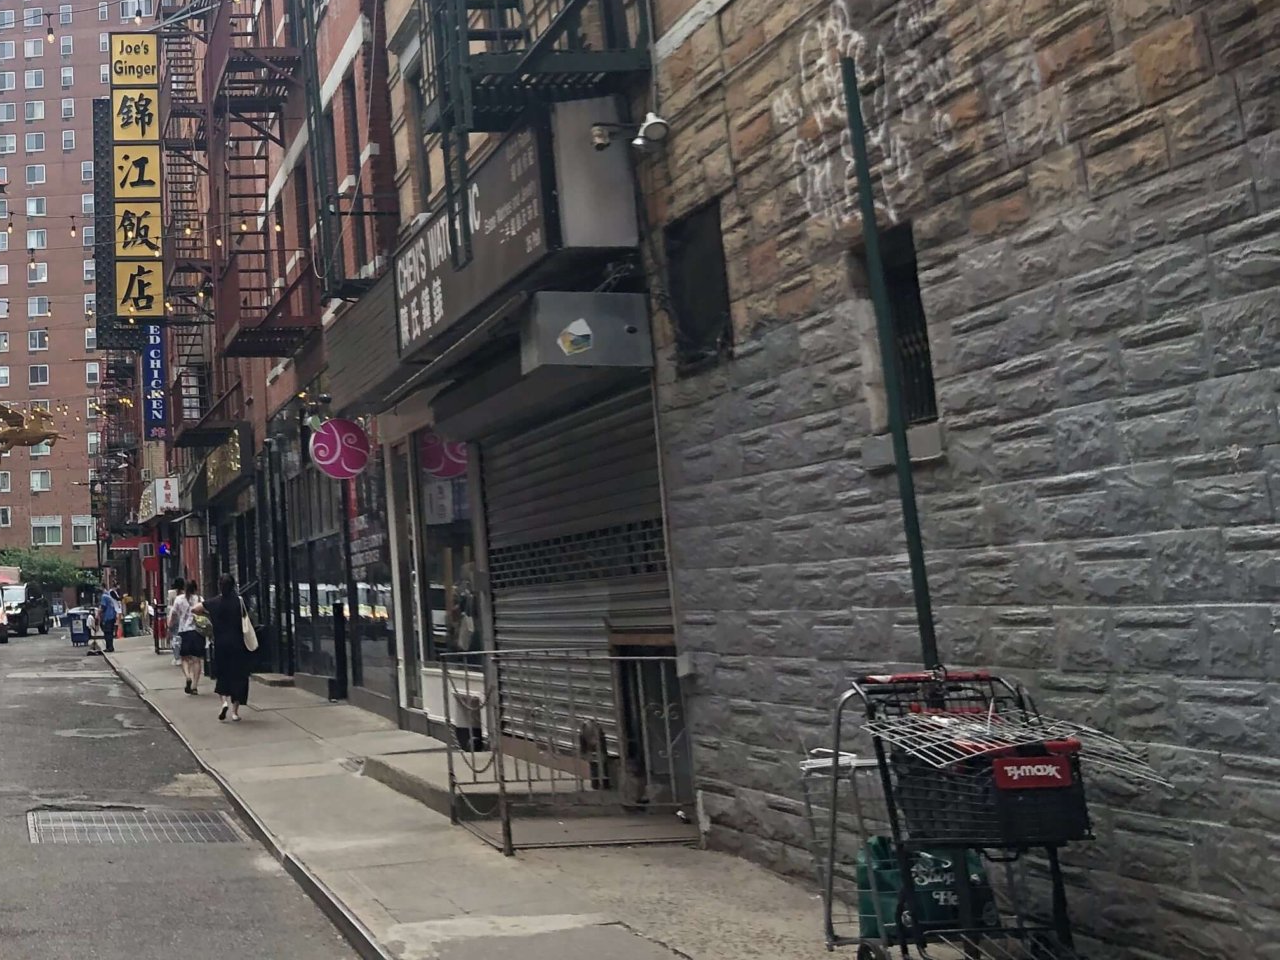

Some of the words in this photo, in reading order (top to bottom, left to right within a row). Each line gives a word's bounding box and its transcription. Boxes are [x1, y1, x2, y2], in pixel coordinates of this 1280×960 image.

[113, 59, 157, 79] Ginger
[119, 39, 149, 55] Joe's
[116, 92, 160, 311] 錦江飯店
[149, 349, 163, 420] CHICKEN
